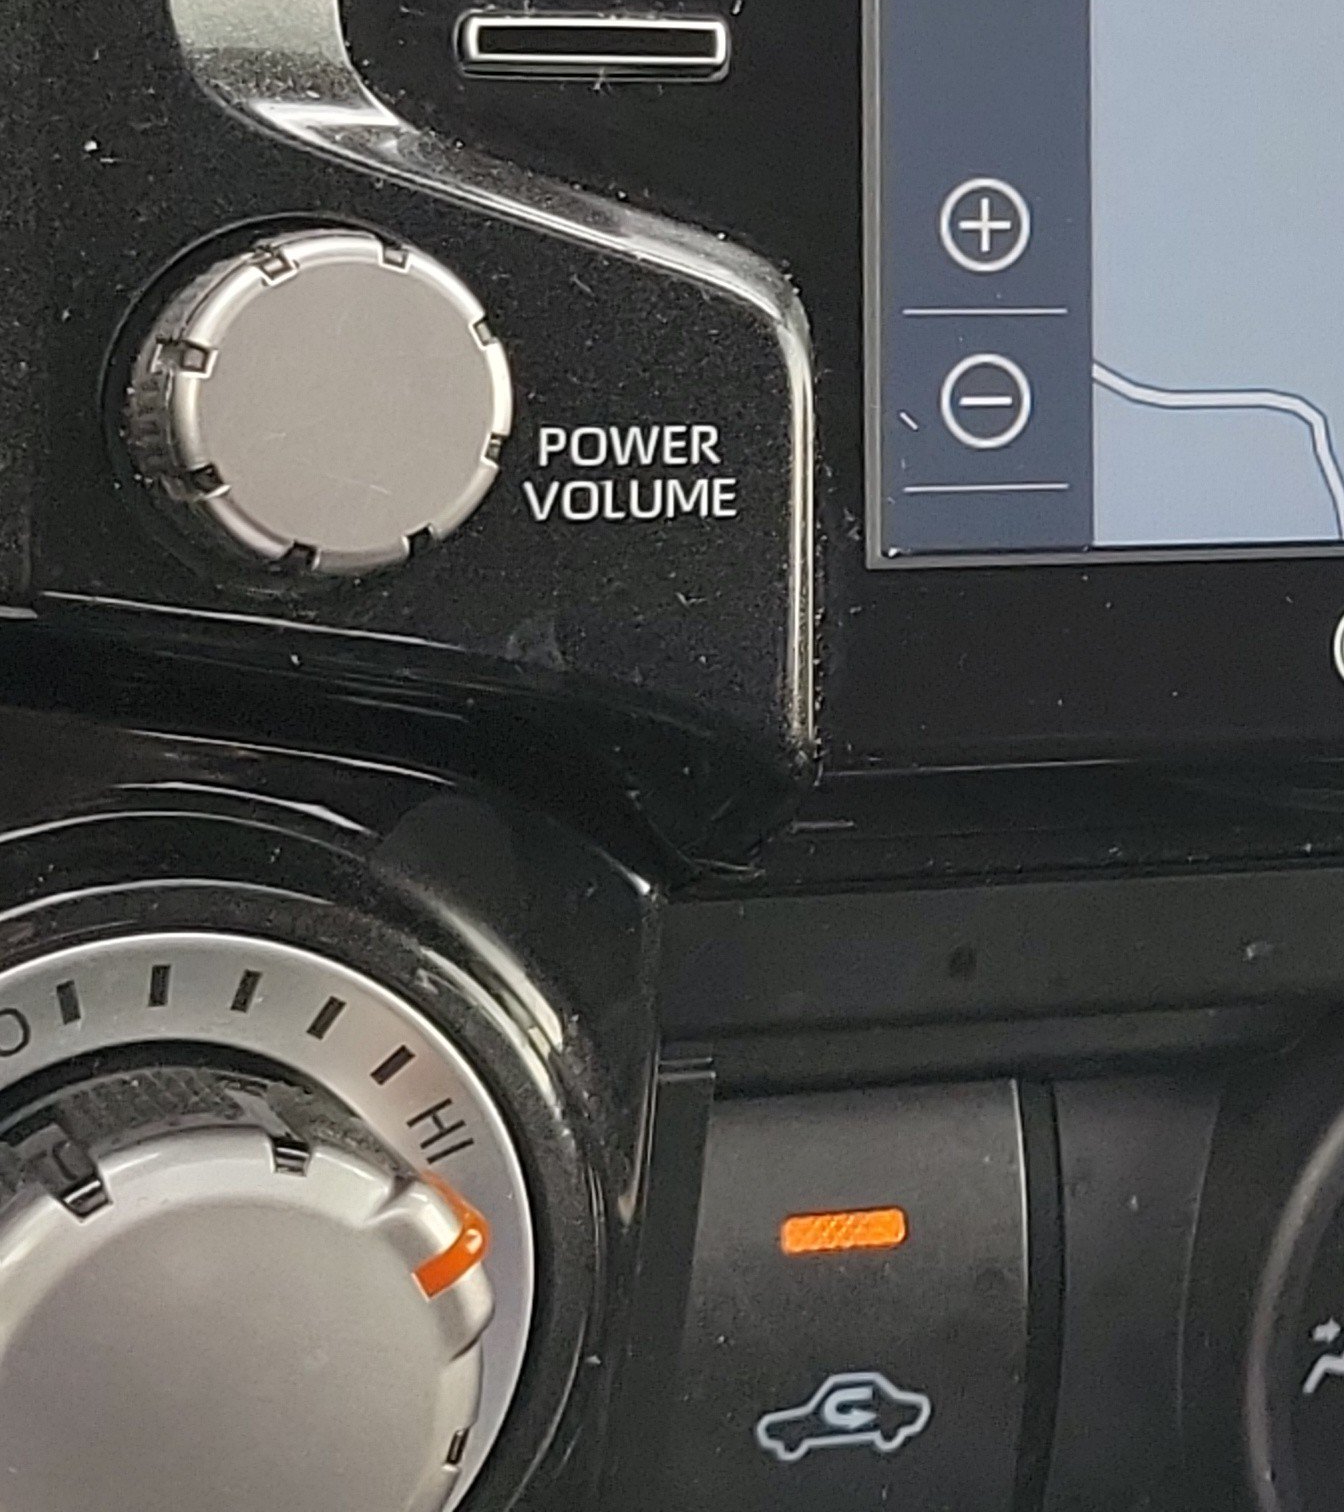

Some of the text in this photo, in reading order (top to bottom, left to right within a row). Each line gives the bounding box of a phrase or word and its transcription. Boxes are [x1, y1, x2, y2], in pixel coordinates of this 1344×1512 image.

[537, 425, 720, 466] POWER
[524, 479, 737, 521] VOLUME
[406, 1098, 475, 1164] HI
